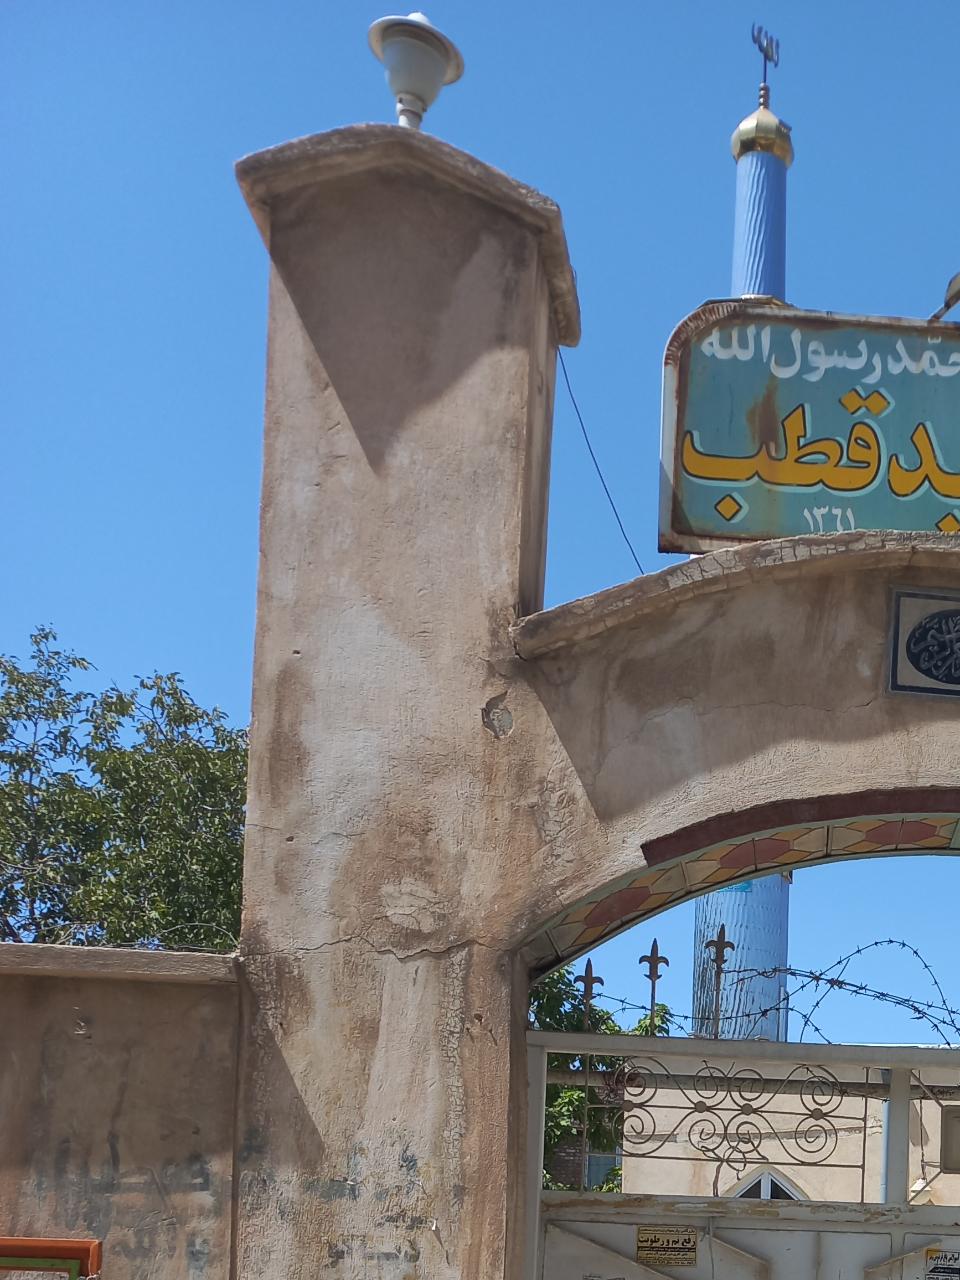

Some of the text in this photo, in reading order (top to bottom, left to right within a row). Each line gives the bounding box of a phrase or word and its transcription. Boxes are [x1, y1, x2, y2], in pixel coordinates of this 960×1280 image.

[701, 323, 771, 363] الله
[769, 327, 882, 384] رسول
[681, 388, 888, 522] قطب
